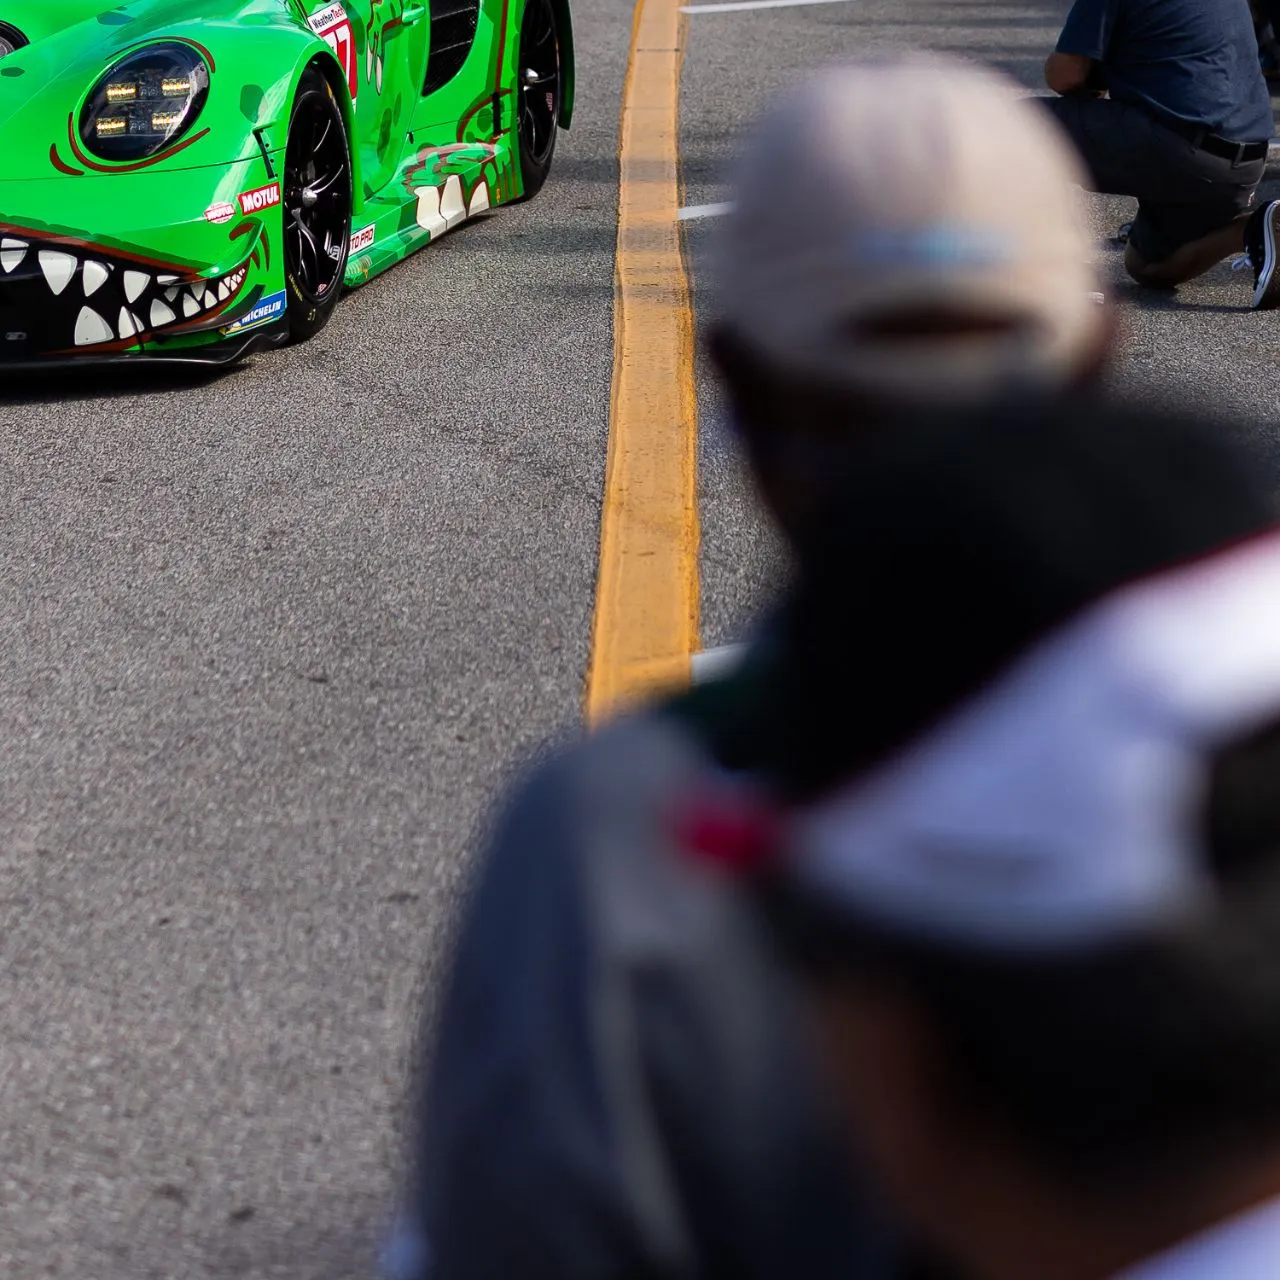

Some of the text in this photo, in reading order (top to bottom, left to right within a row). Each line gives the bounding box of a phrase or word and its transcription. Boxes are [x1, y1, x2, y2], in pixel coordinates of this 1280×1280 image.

[311, 5, 345, 29] WeatherTech
[241, 185, 280, 213] MOTUL
[241, 300, 282, 324] MICHELIN
